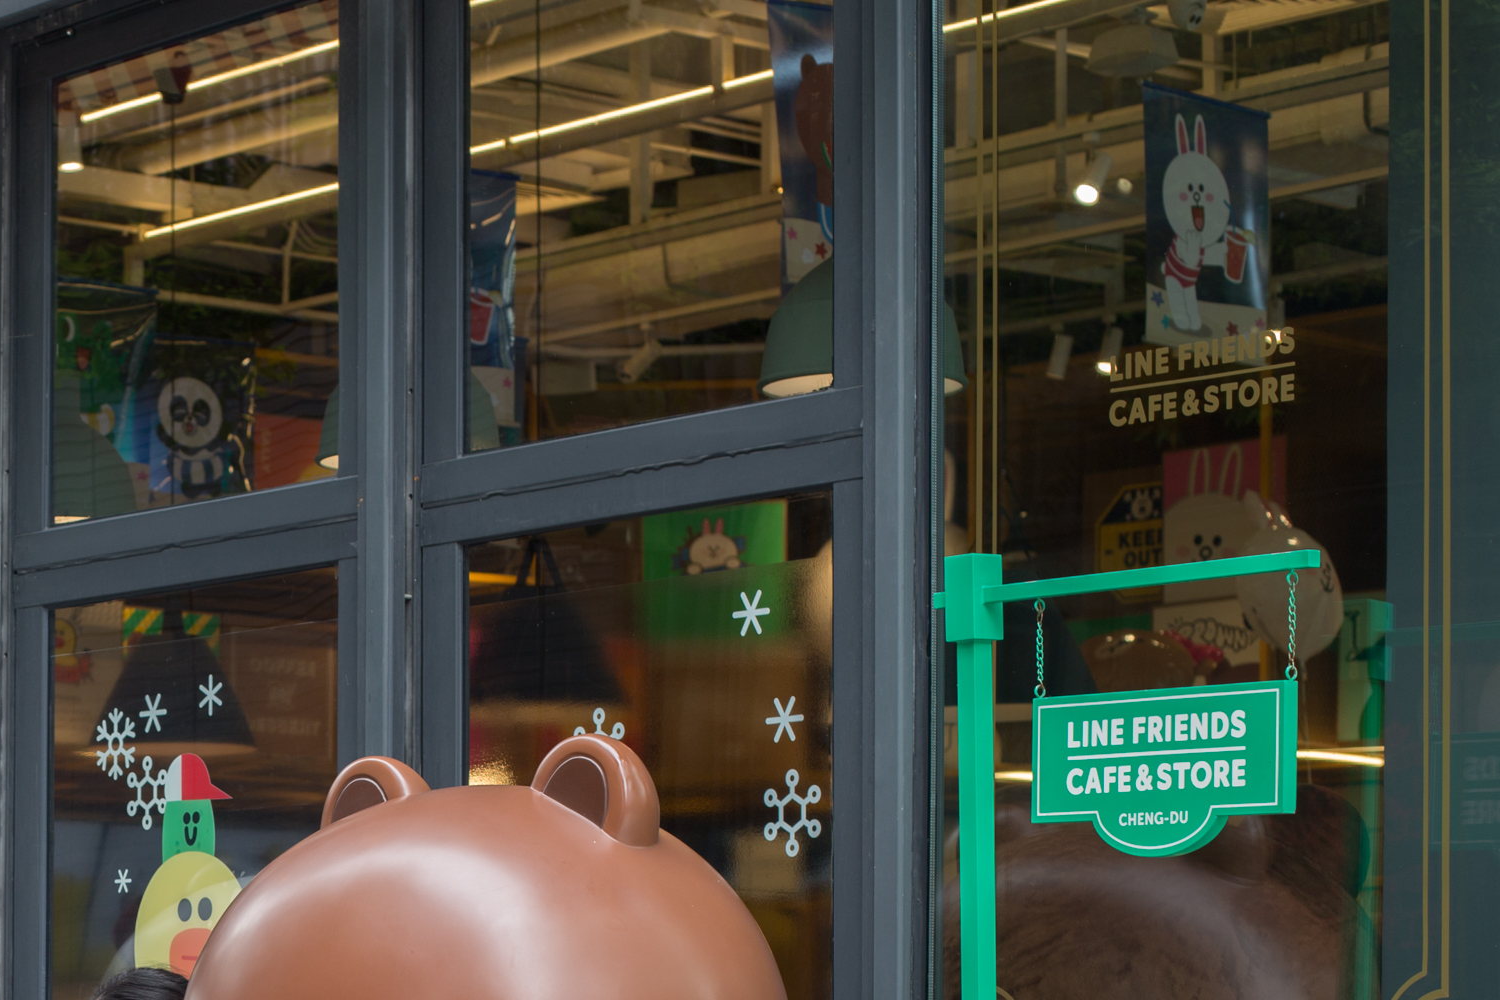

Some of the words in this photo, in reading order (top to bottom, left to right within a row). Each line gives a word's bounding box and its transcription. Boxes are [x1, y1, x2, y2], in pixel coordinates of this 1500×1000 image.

[1110, 347, 1169, 382] LINE
[1178, 326, 1296, 371] FRIENDS
[1124, 548, 1163, 568] OUT
[1067, 718, 1124, 748] LINE
[1132, 709, 1247, 744] FRIENDS
[1118, 810, 1189, 826] CHENG-DU
